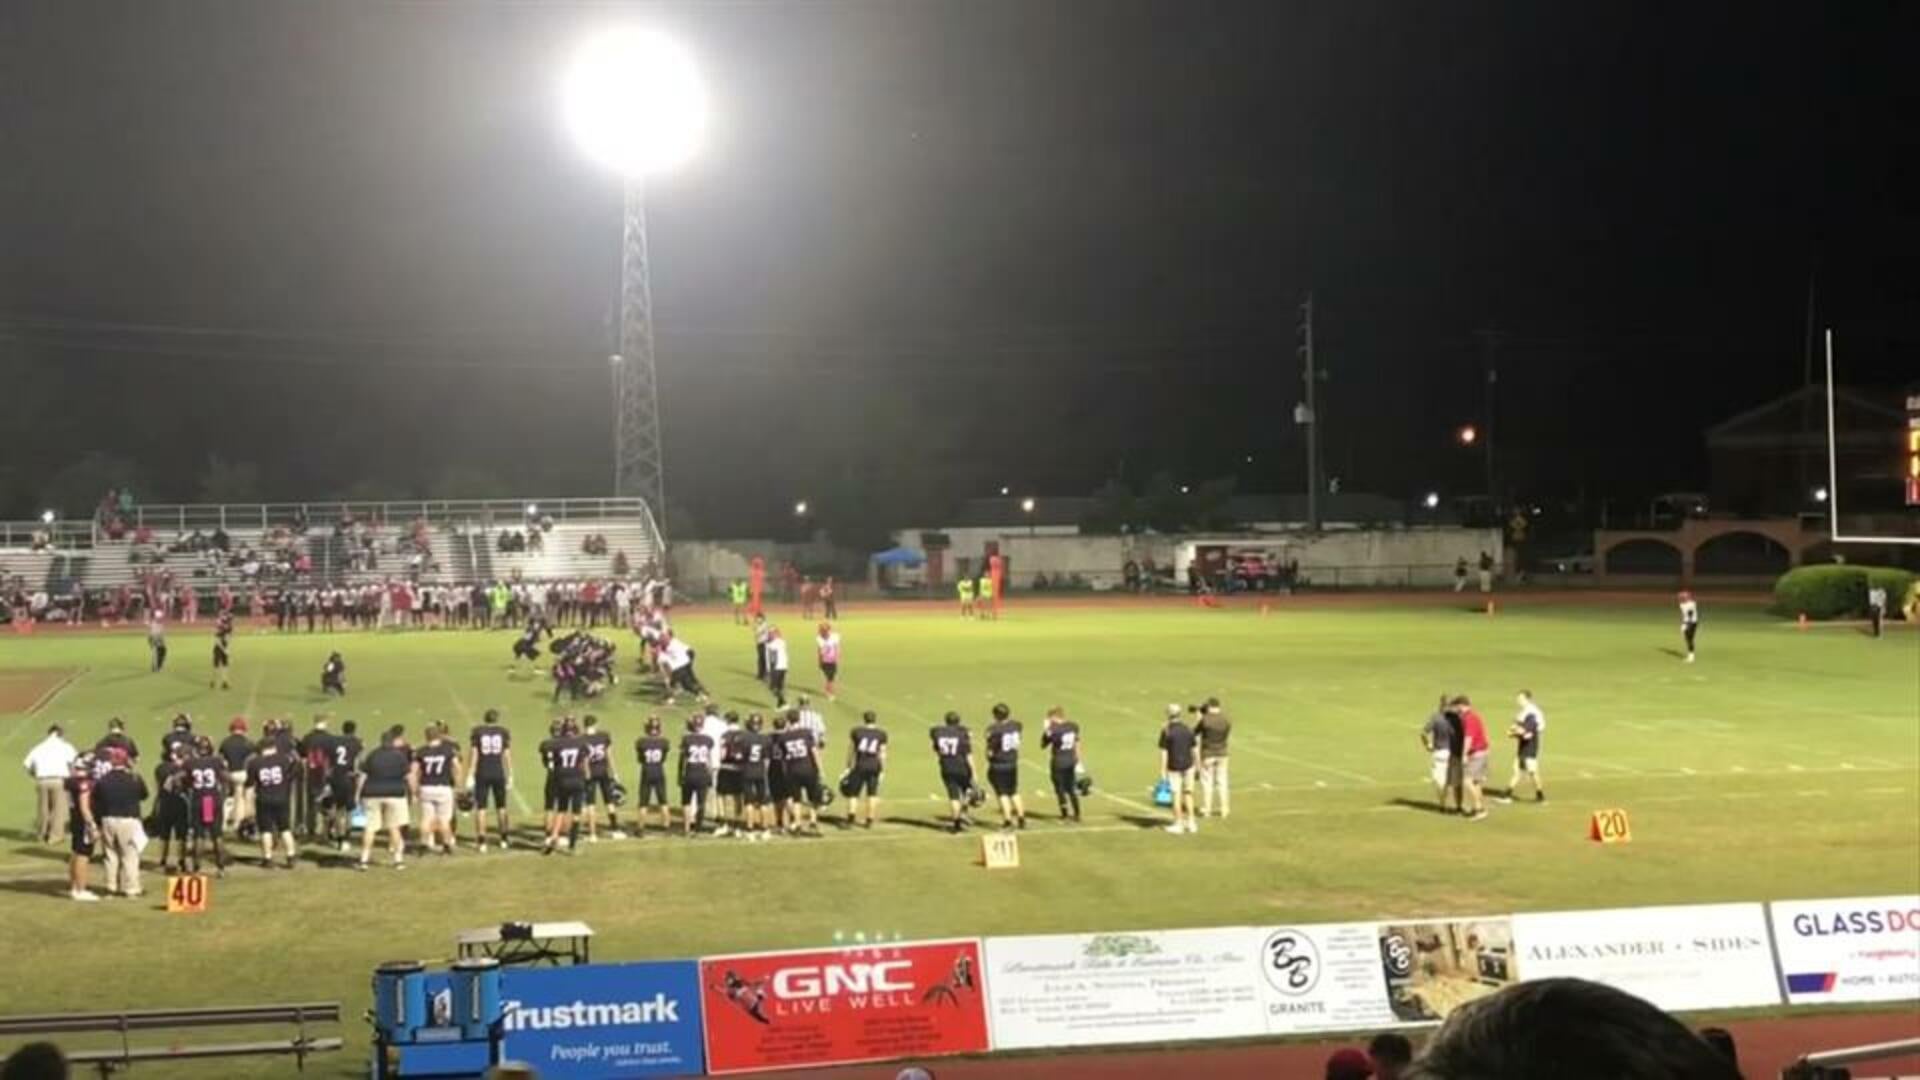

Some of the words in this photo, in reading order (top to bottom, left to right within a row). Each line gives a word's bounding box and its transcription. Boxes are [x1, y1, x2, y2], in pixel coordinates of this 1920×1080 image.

[336, 745, 347, 766] 2
[560, 748, 579, 769] 17
[749, 744, 762, 762] 5
[424, 755, 446, 775] 77
[192, 768, 216, 789] 33
[1602, 812, 1627, 838] 20
[172, 878, 203, 906] 40
[1793, 910, 1885, 937] GLASS
[773, 960, 915, 998] GNC
[500, 993, 679, 1031] Trustmark
[775, 998, 832, 1017] LIVE
[848, 992, 915, 1009] WELL
[1269, 1000, 1328, 1016] GRANITE
[550, 1044, 601, 1062] People
[601, 1043, 631, 1061] you
